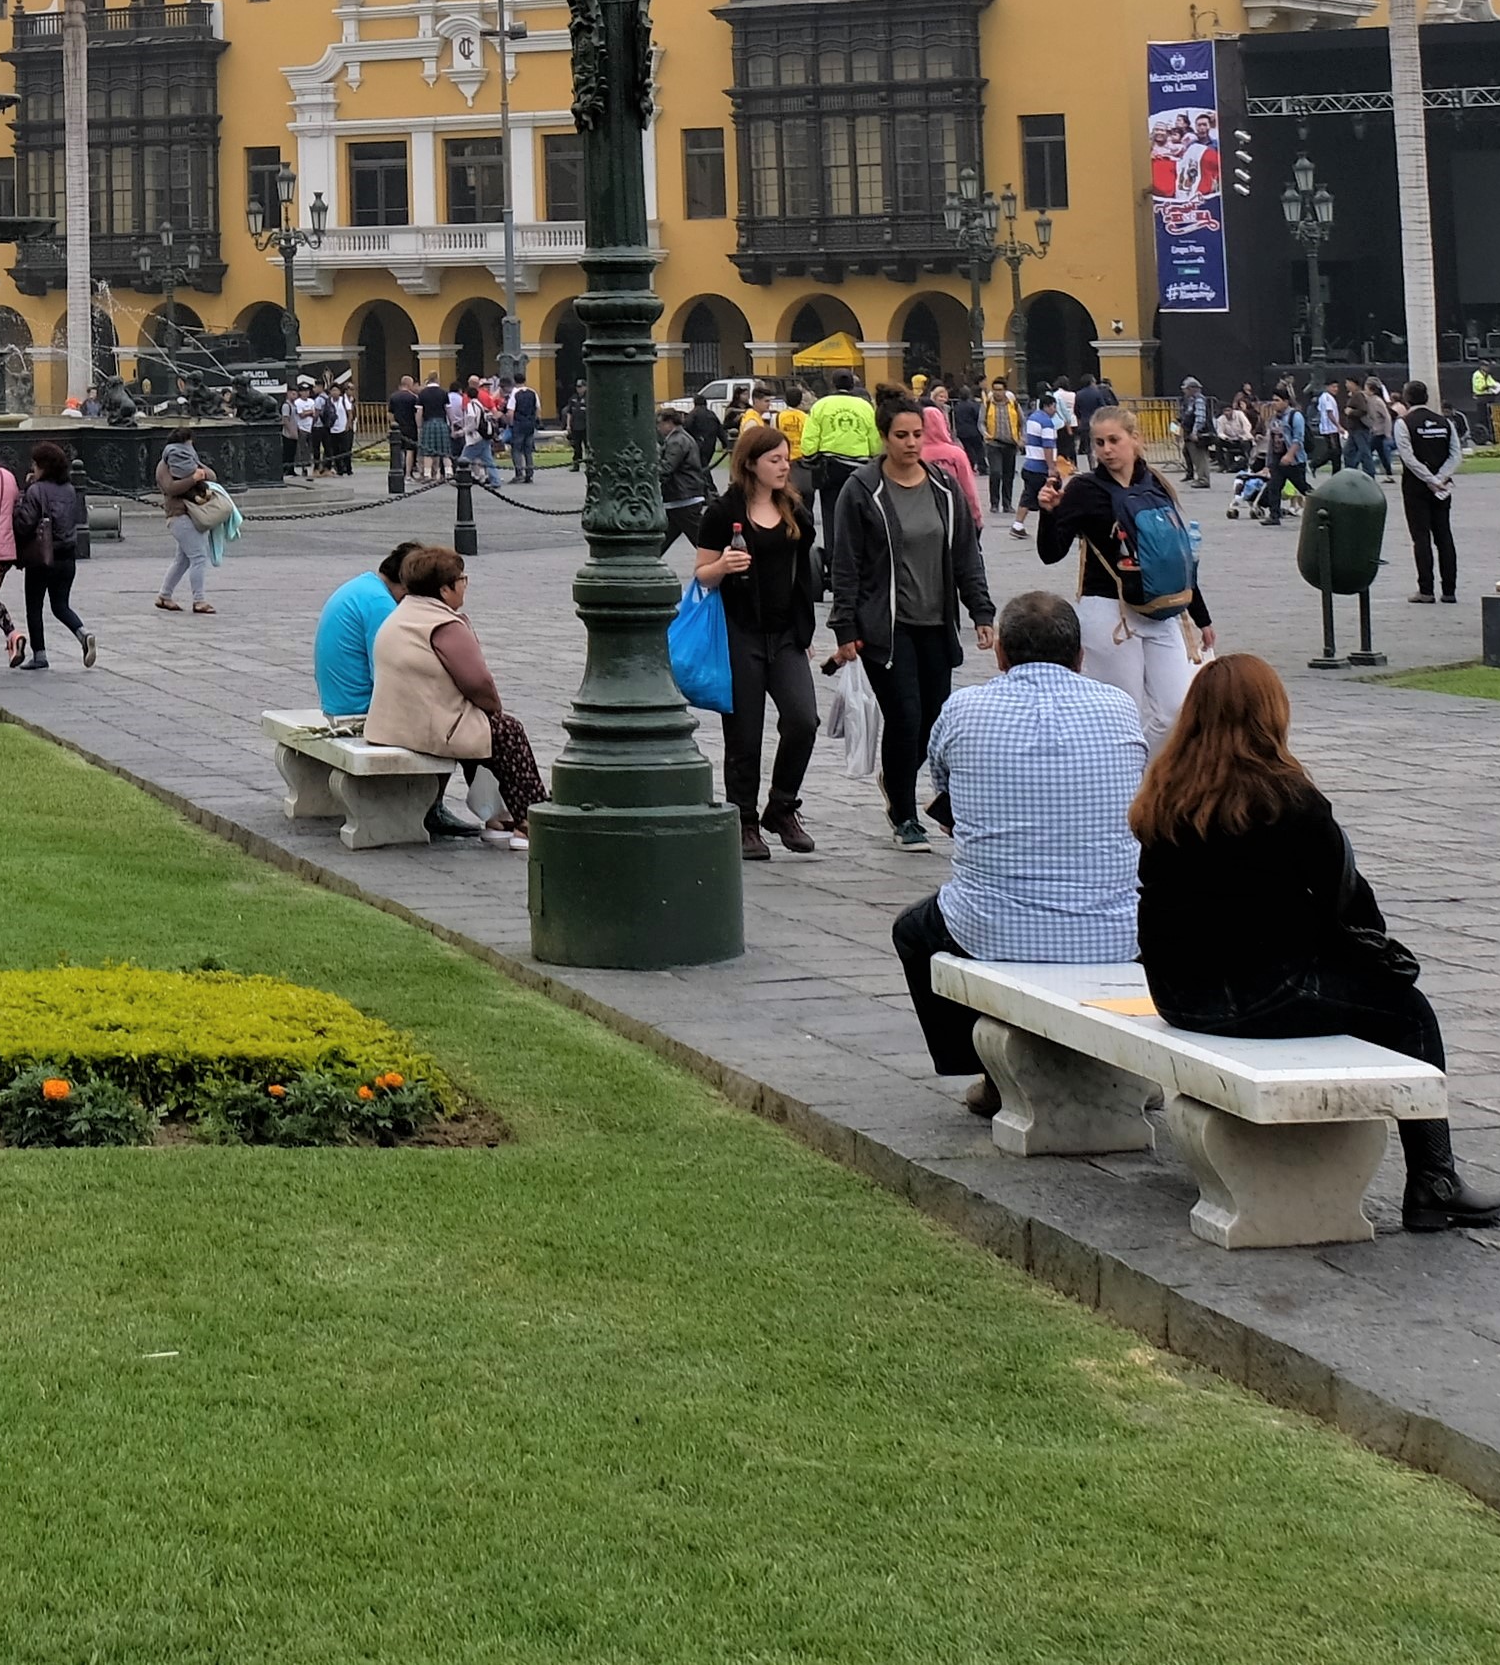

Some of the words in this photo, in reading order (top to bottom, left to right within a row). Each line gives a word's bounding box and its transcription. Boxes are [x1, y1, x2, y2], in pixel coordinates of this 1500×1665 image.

[1150, 70, 1208, 82] Municipalidad
[1162, 84, 1173, 92] de
[1175, 83, 1197, 92] Lima
